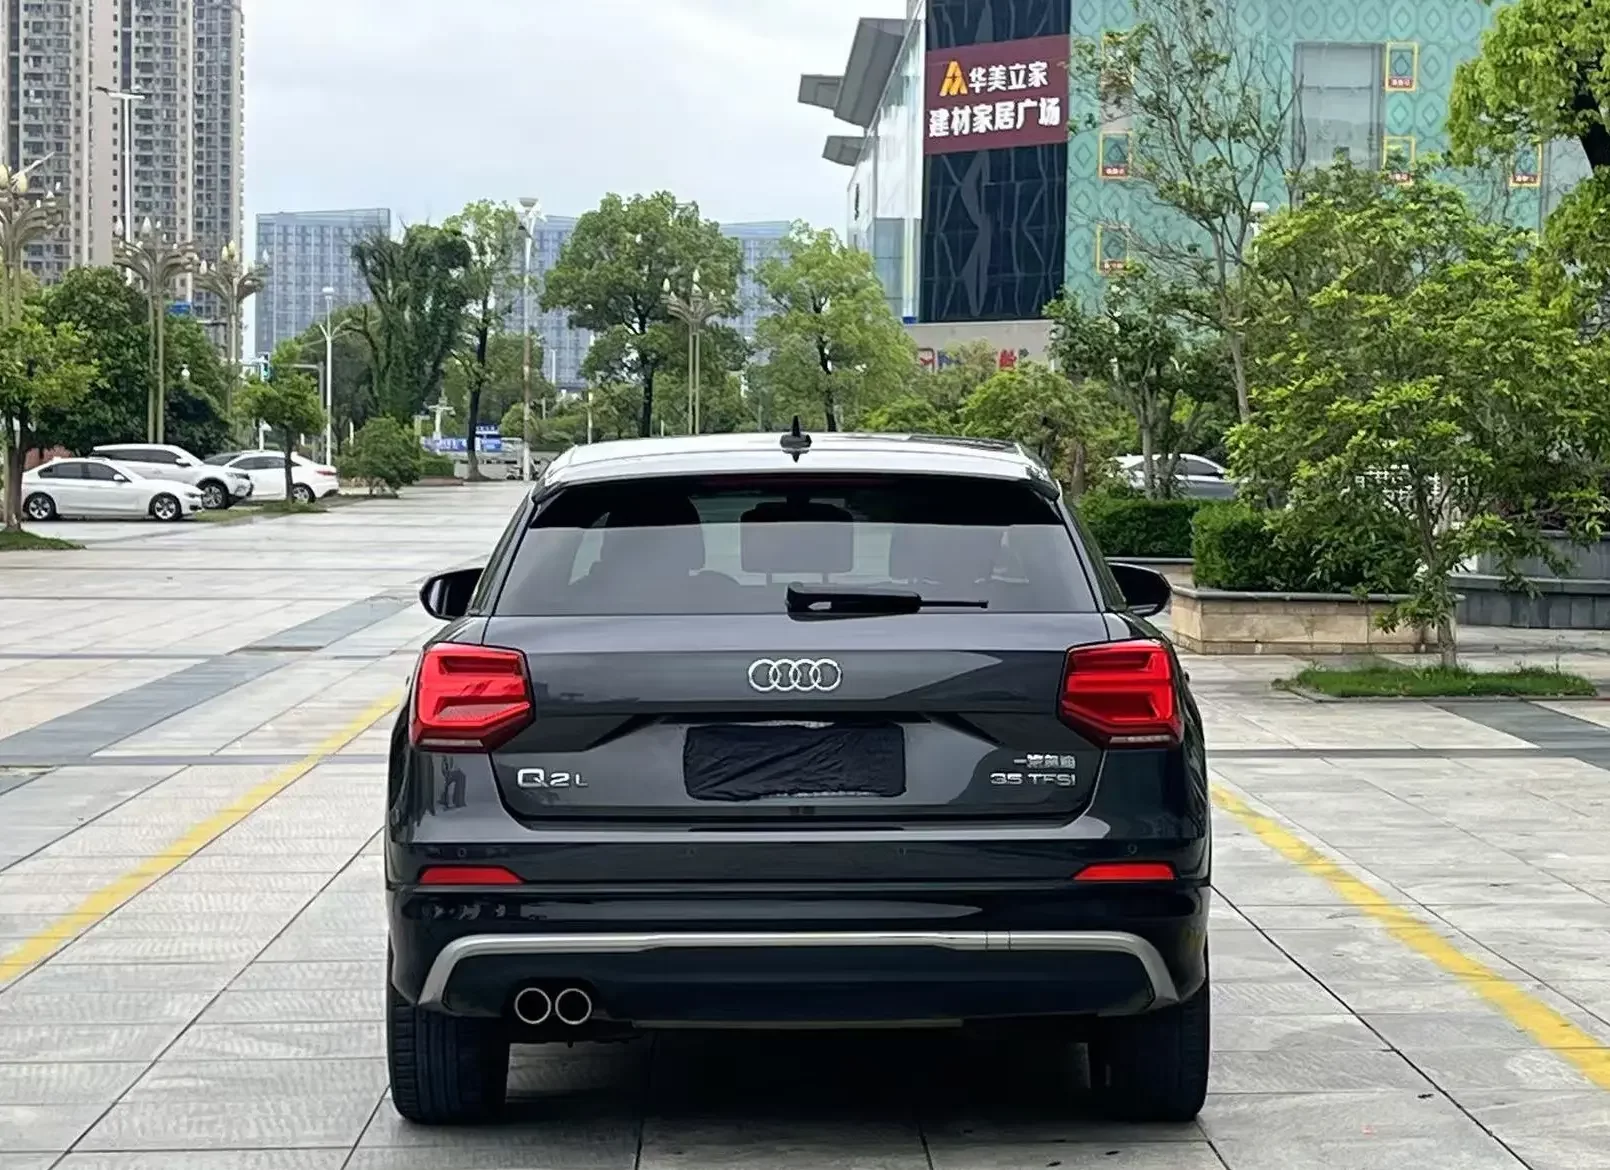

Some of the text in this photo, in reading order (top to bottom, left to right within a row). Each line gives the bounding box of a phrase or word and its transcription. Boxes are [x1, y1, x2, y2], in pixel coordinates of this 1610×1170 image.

[968, 61, 1048, 93] 华美立家
[928, 97, 1061, 137] 建材家居广场
[990, 772, 1076, 786] 35 TFSI
